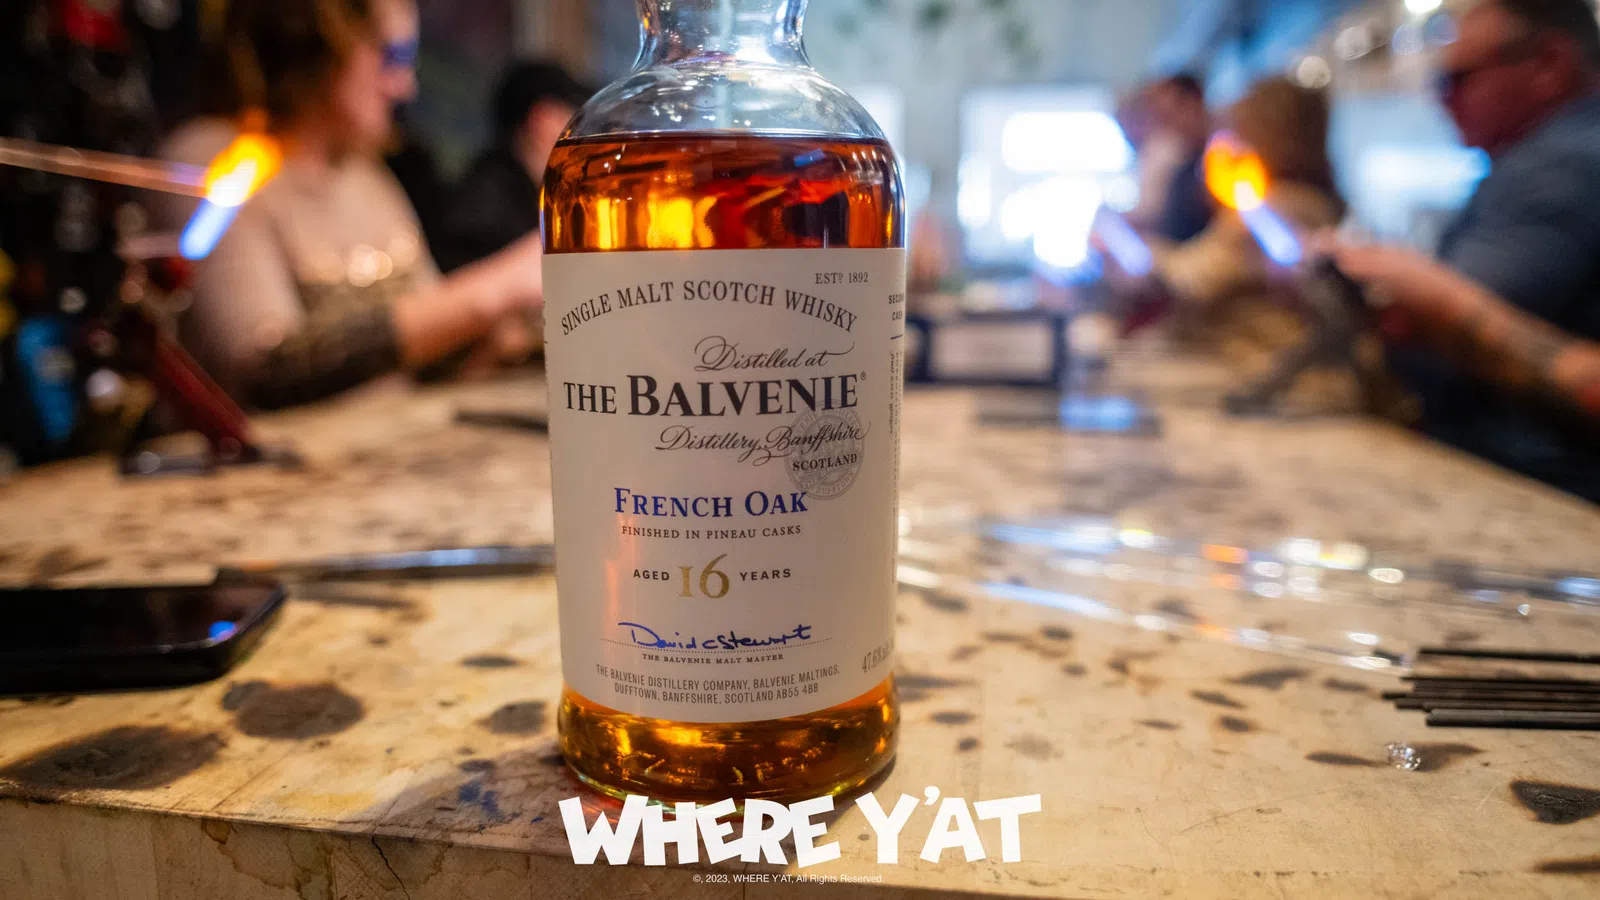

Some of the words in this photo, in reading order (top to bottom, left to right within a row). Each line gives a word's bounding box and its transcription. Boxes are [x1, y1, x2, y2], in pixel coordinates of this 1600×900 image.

[848, 272, 868, 284] 1892
[561, 294, 612, 335] SINGLE
[617, 282, 674, 309] MALT
[683, 280, 776, 306] SCOTCH
[785, 289, 857, 332] WHISKY
[694, 335, 801, 372] Distilled
[804, 342, 855, 367] at
[563, 381, 617, 414] THE
[655, 424, 763, 463] Distillery,
[755, 421, 871, 466] Banffshire
[792, 454, 858, 472] SCOTLAND
[614, 487, 733, 517] FRENCH
[745, 490, 808, 516] OAK
[622, 526, 680, 539] FINISHED
[686, 528, 700, 540] IN
[706, 526, 756, 540] PINEAU
[762, 524, 802, 538] CASKS
[633, 569, 670, 582] AGED
[678, 553, 730, 598] 16
[740, 568, 792, 582] YEARS
[618, 622, 697, 650] David
[642, 653, 660, 662] THE
[664, 654, 712, 664] BALVENIE
[746, 653, 784, 664] MASTER
[596, 664, 608, 678] THE
[610, 668, 645, 686] BALVENIE
[648, 676, 700, 690] DISTILLERY
[754, 674, 795, 689] BALVENIE
[725, 686, 774, 704] SCOTLAND
[776, 686, 800, 700] AB55
